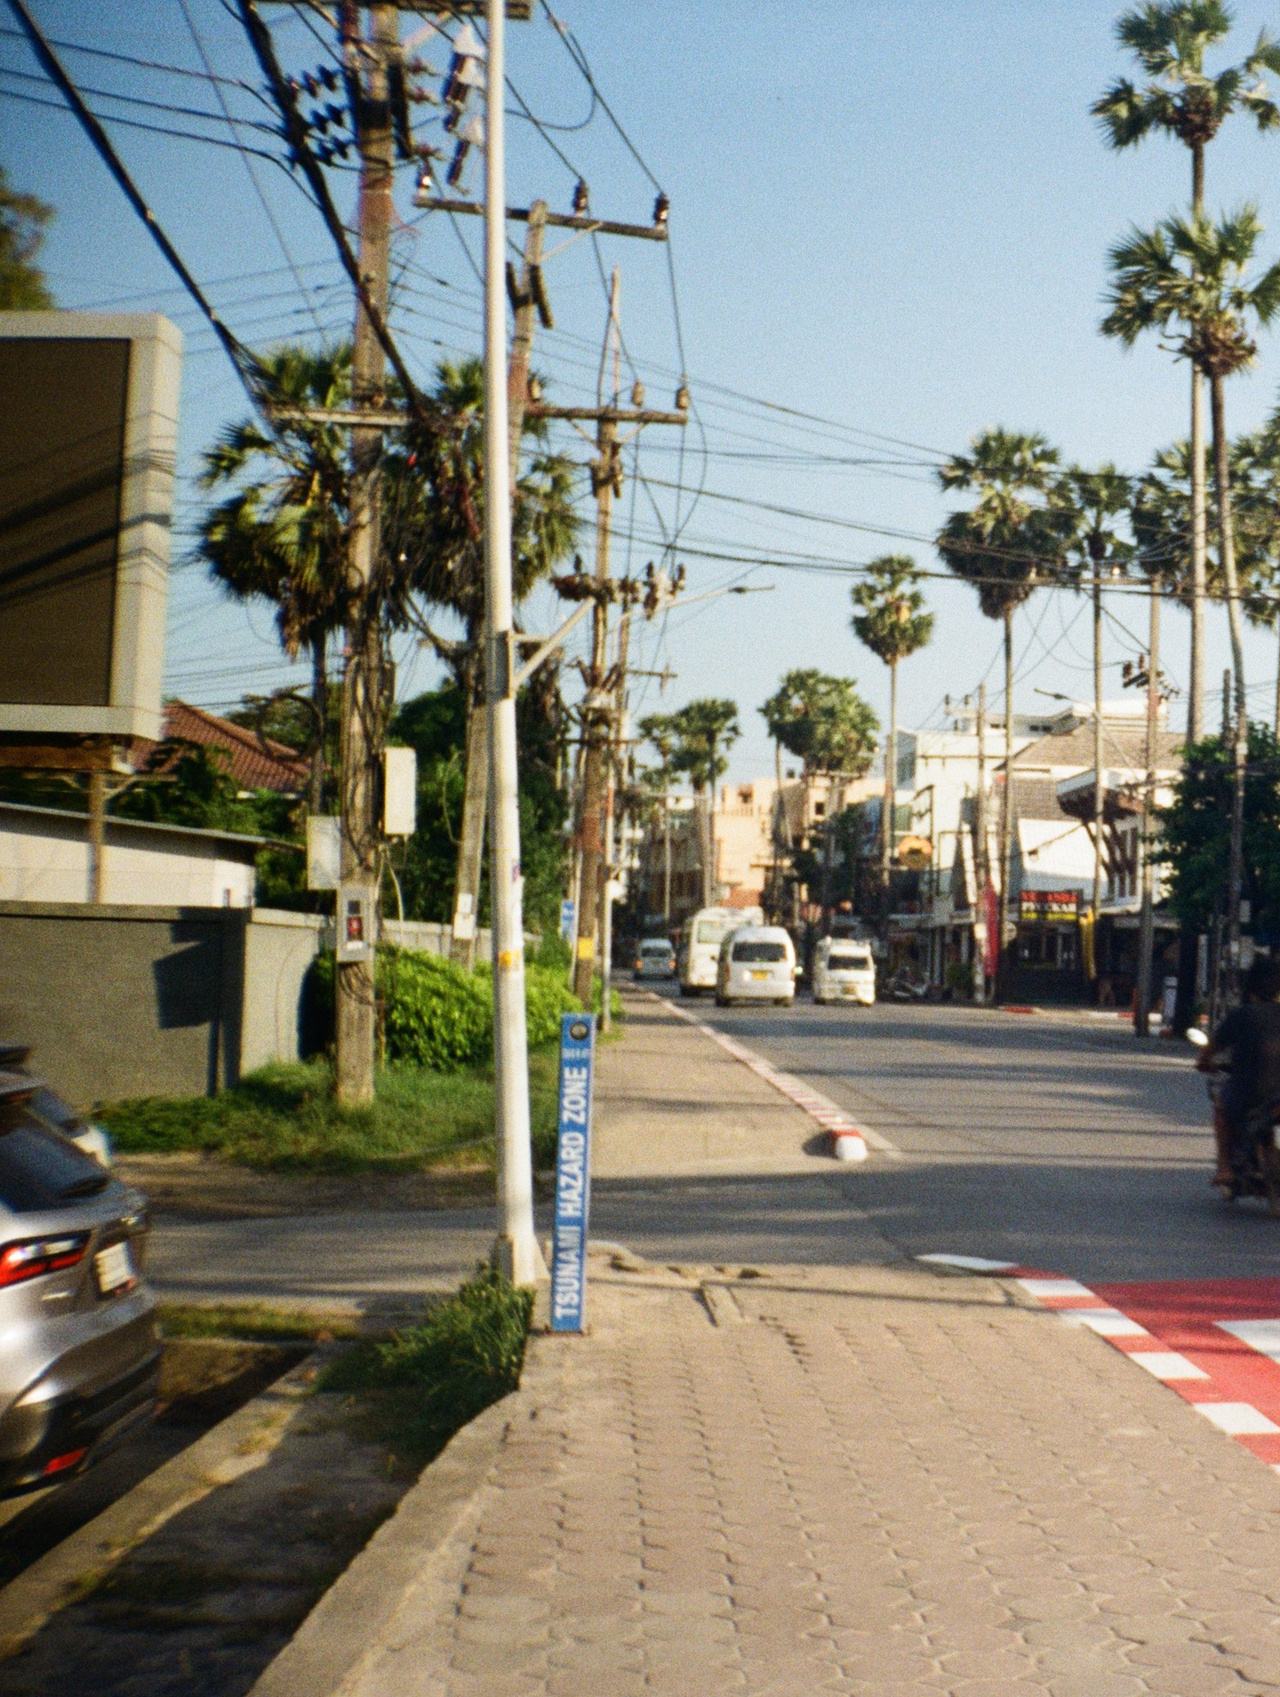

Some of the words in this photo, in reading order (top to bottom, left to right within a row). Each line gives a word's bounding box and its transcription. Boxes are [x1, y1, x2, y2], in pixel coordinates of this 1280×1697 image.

[563, 1066, 587, 1125] ZONE
[559, 1131, 585, 1217] HAZARD
[555, 1225, 581, 1320] TSUNAMI
